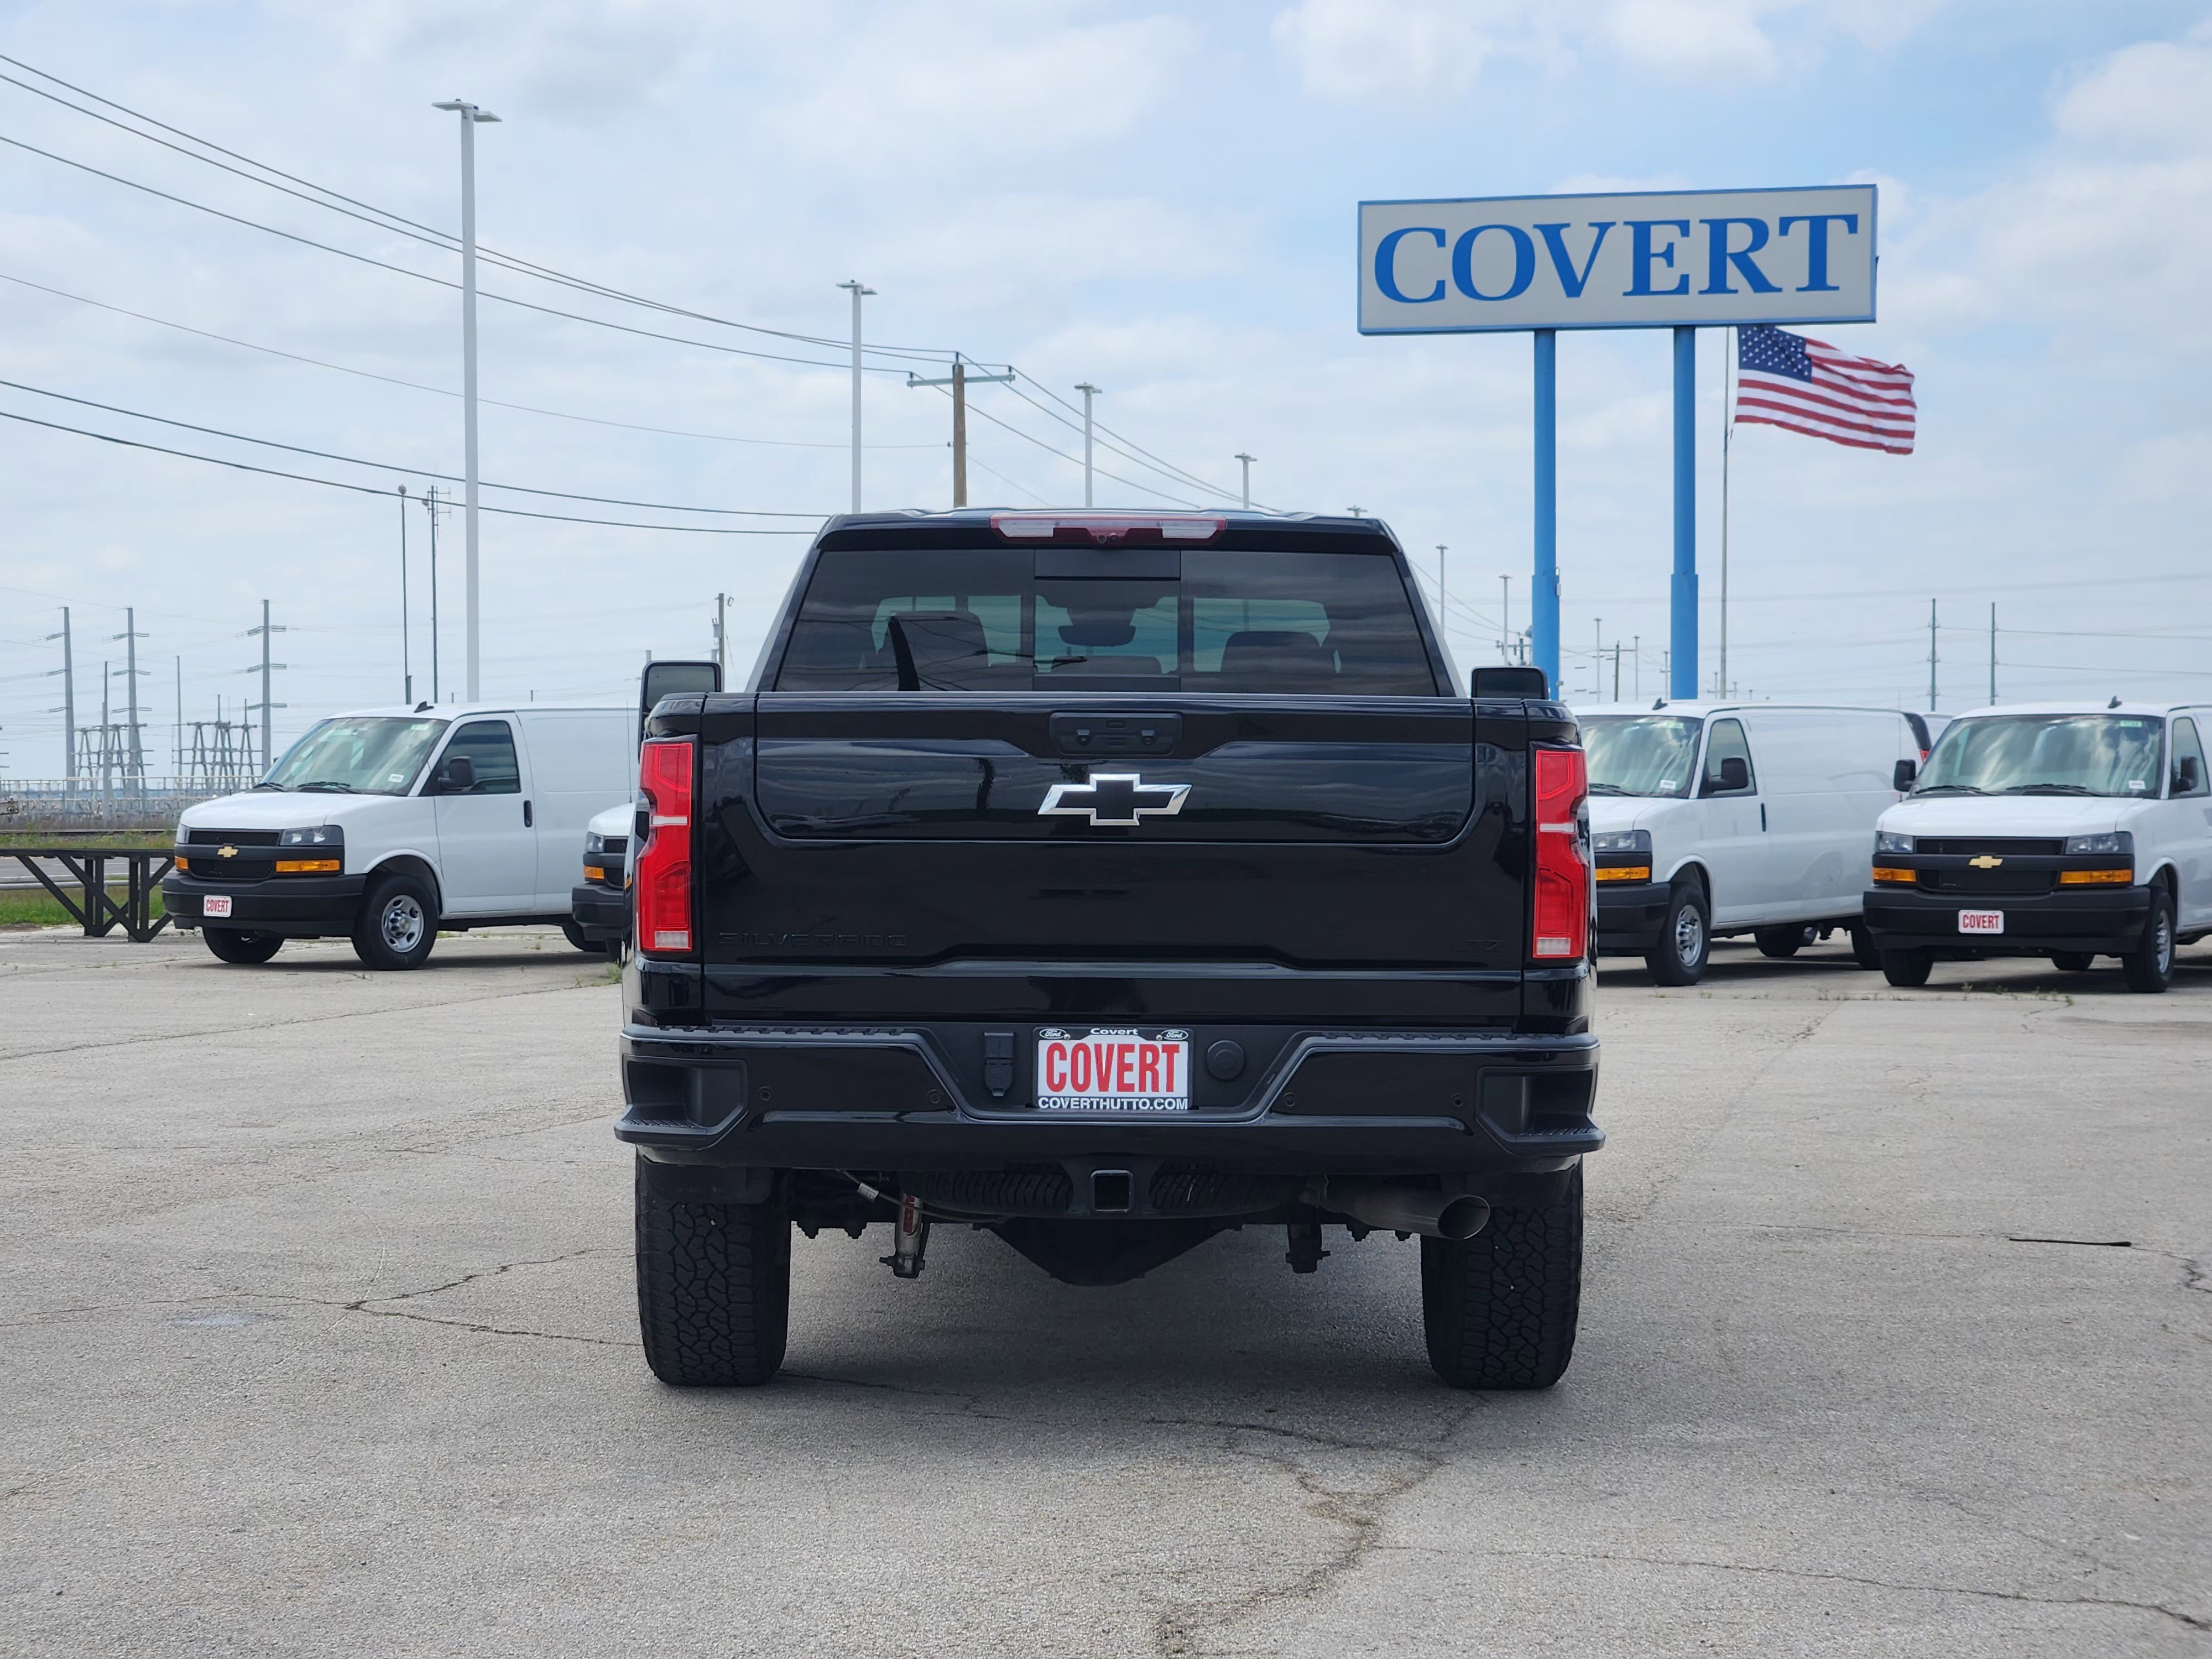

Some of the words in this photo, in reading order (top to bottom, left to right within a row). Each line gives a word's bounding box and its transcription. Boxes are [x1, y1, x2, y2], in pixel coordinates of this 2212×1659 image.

[1374, 213, 1858, 304] COVERT
[206, 899, 229, 912] COVERT
[1963, 915, 1999, 928] COVERT
[718, 932, 910, 947] SILVERADO
[1046, 1042, 1180, 1093] COVERT
[1038, 1097, 1188, 1110] COVERTHUTTO.COM
